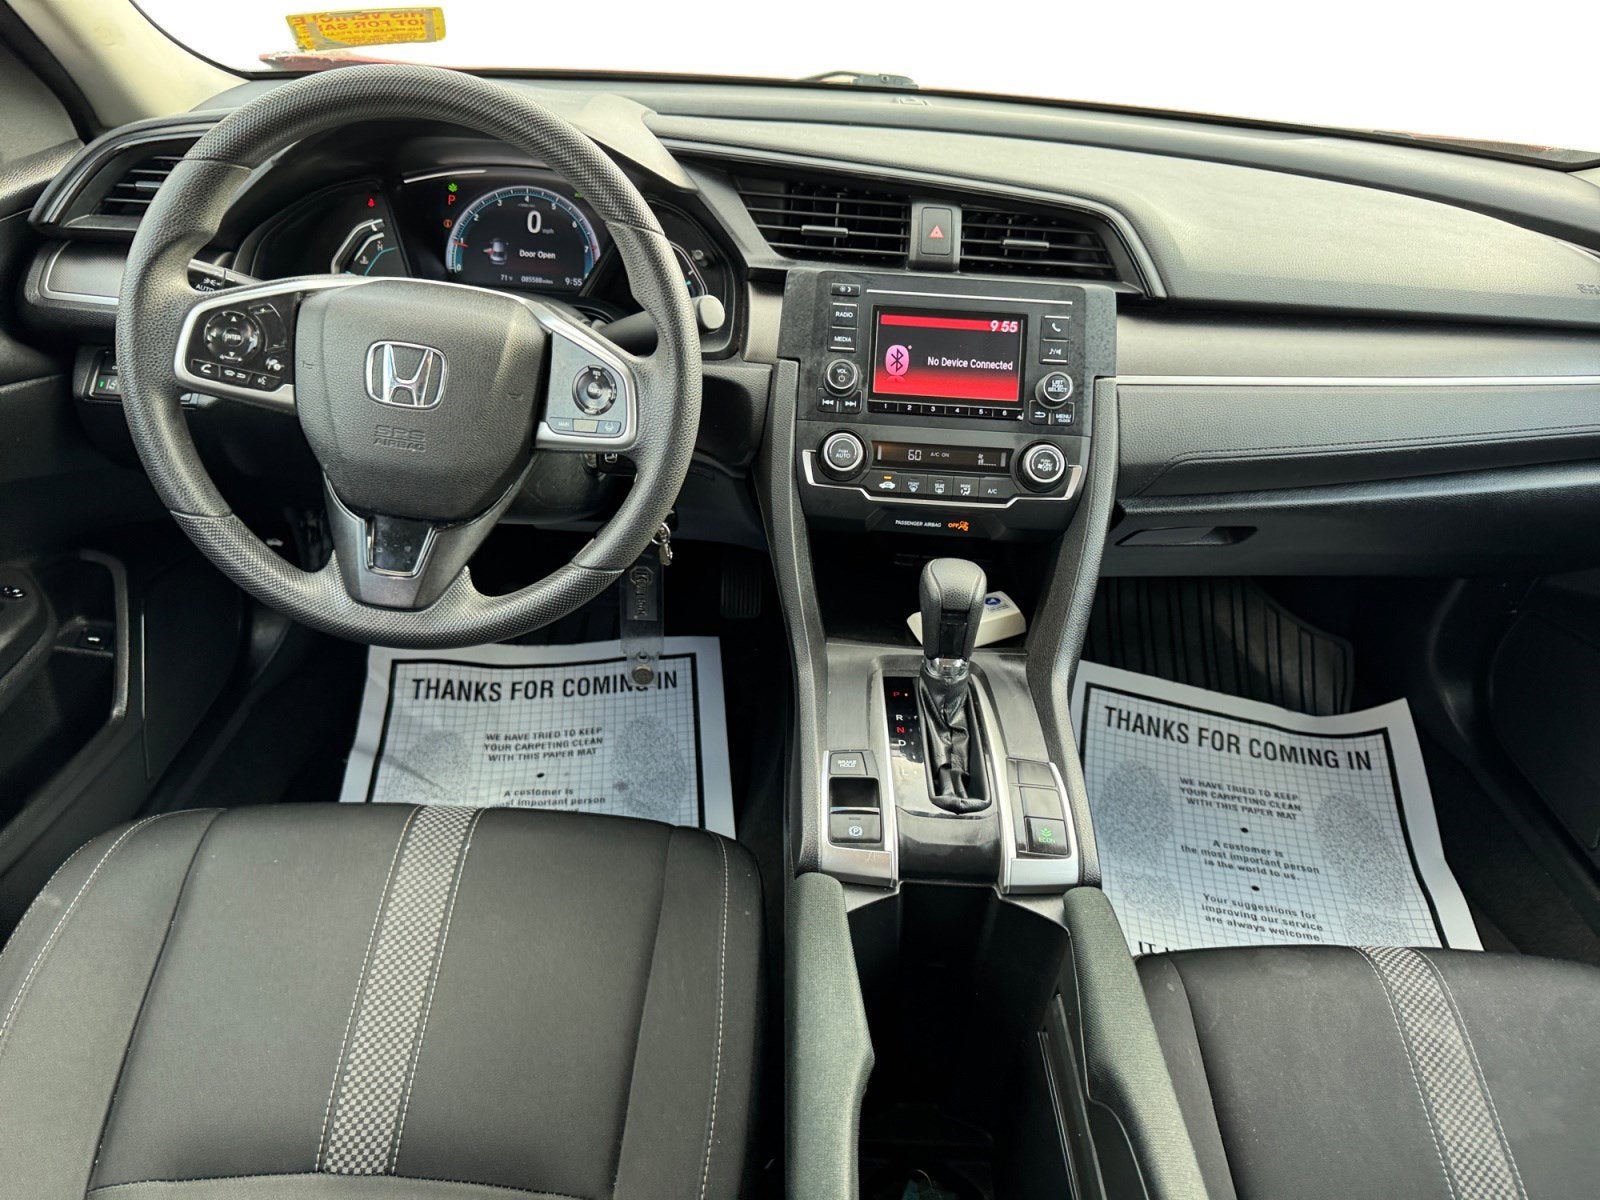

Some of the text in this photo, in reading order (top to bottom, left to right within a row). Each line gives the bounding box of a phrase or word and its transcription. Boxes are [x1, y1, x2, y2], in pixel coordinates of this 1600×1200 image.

[527, 210, 542, 234] 0
[519, 248, 556, 260] Door Open
[834, 335, 852, 343] MEDIA
[927, 356, 1013, 371] No Device Connected
[412, 671, 677, 702] THANKS FOR COMIN IN
[486, 726, 602, 741] WE HAVE TRIED TO KEEP
[1105, 705, 1372, 771] THANKS FOR COMING IN
[484, 737, 603, 752] YOUR CARPETING CLEAN
[519, 752, 540, 760] THIS
[543, 749, 574, 758] PAPER
[577, 747, 597, 756] MAT
[514, 788, 561, 796] customer
[1180, 777, 1298, 801] WE HAVE TRIED TO KEEP
[518, 797, 568, 807] important
[571, 796, 606, 806] person
[1180, 787, 1301, 812] YOUR CARPETING CLEAN
[1186, 797, 1297, 820] WITH THIS PAPER MAT
[1213, 840, 1284, 858] A customer is
[1181, 845, 1320, 874] the most important person
[1217, 860, 1234, 869] the
[1238, 864, 1267, 875] world
[1270, 869, 1281, 878] to
[1203, 892, 1317, 920] Your suggestions for
[1201, 903, 1324, 932] improving our service
[1205, 915, 1223, 924] are
[1227, 919, 1266, 932] always
